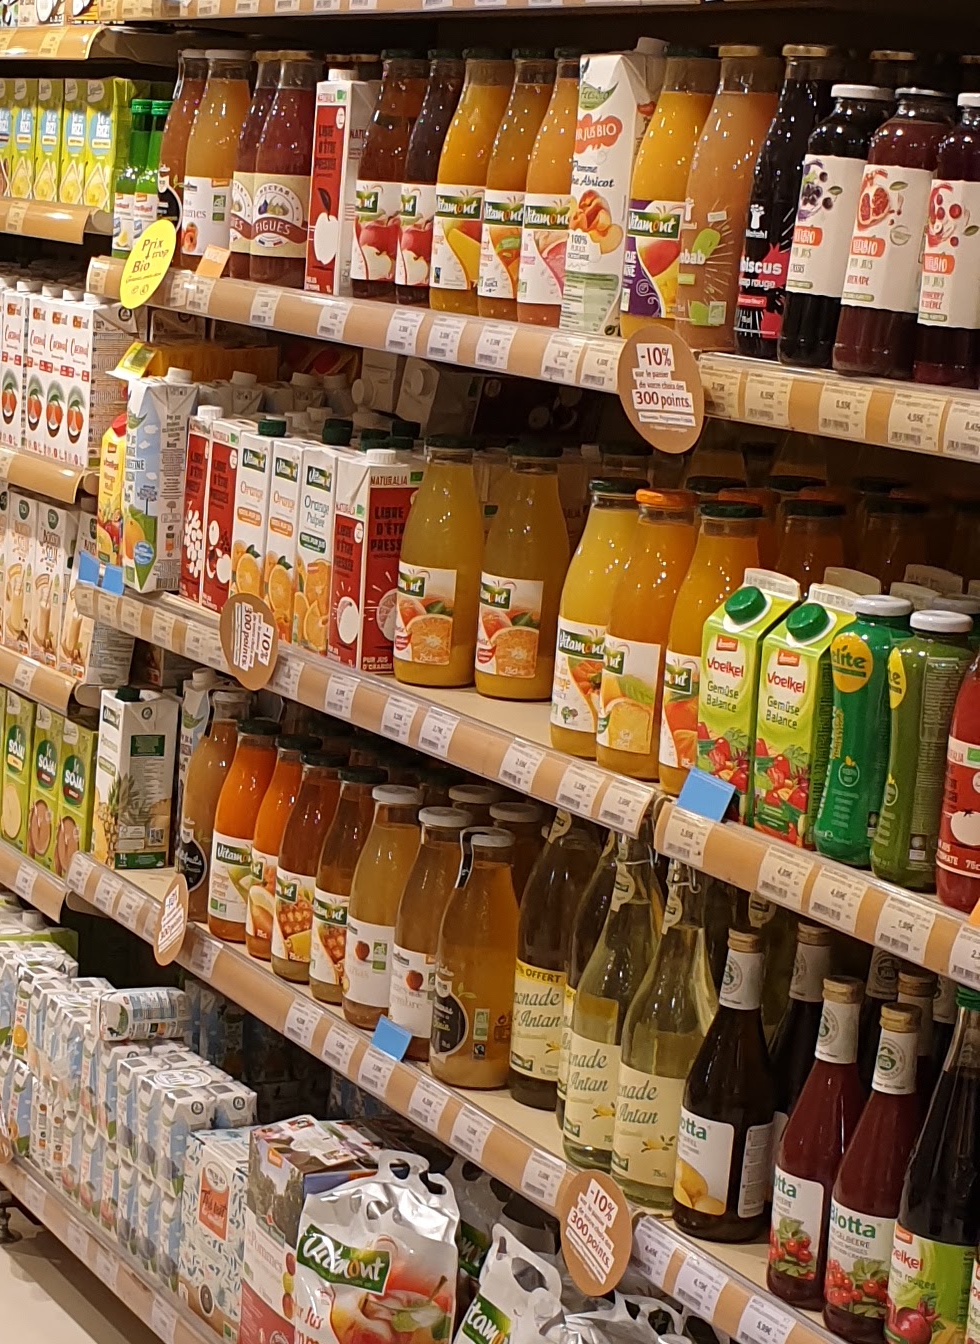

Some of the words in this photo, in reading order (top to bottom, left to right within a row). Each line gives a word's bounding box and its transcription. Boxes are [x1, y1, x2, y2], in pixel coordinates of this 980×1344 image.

[597, 123, 617, 136] BIO
[580, 175, 615, 188] Abricot
[255, 221, 291, 235] FIGUES
[141, 238, 164, 255] Prix
[679, 248, 706, 265] obab
[132, 260, 151, 274] Bio
[741, 256, 782, 275] biscus
[641, 346, 672, 367] -10%
[635, 391, 659, 406] 300
[661, 393, 692, 409] points.
[370, 474, 408, 486] NATURALIA
[304, 495, 330, 517] Orange
[371, 538, 402, 552] PRESS
[244, 605, 253, 631] 300
[240, 631, 250, 668] points.
[259, 626, 271, 666] -10%
[707, 657, 744, 678] Voelkel
[707, 680, 739, 700] Gemüse
[767, 671, 805, 694] Voelkel
[706, 695, 737, 713] Balance
[767, 696, 800, 716] Gemüse
[765, 710, 798, 730] Balance
[217, 844, 252, 864] Vitamo
[965, 857, 980, 870] 75c
[525, 970, 561, 984] OFFERT
[515, 987, 561, 1007] onade
[517, 1009, 561, 1028] Antan
[570, 1048, 608, 1069] nade
[570, 1073, 608, 1092] Antan
[619, 1080, 658, 1101] nade
[619, 1104, 658, 1125] Antan
[679, 1116, 708, 1141] otta
[774, 1174, 797, 1199] otta
[590, 1188, 615, 1222] -10%
[570, 1212, 589, 1236] 300
[586, 1234, 611, 1269] points.
[893, 1246, 924, 1271] elkel
[305, 1306, 324, 1331] Jus
